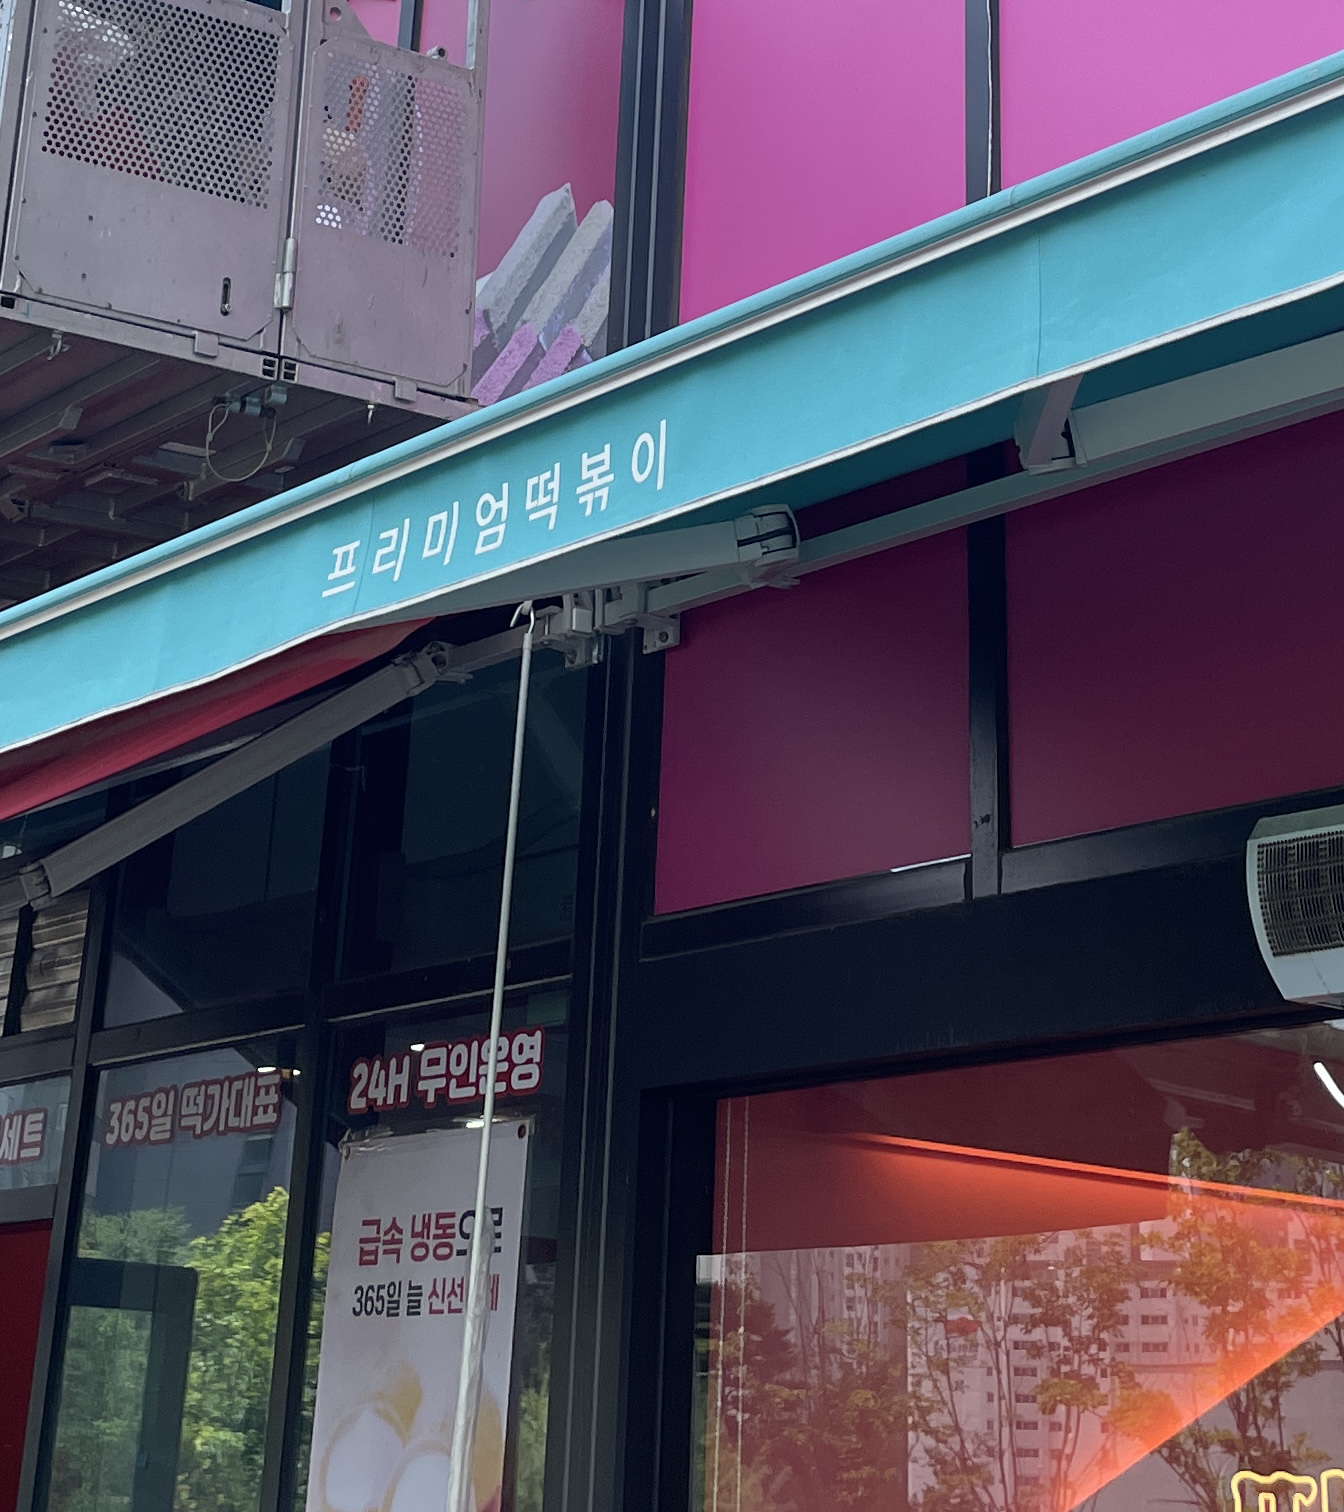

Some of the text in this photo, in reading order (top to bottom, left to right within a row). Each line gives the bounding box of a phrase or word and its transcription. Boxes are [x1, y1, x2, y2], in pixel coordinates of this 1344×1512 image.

[321, 419, 667, 598] 프리미엄떡볶이
[349, 1028, 543, 1110] 24H 무인운영
[105, 1087, 175, 1145] 365일
[358, 1216, 404, 1266] 급속
[352, 1273, 500, 1318] 365일 늘 신선
